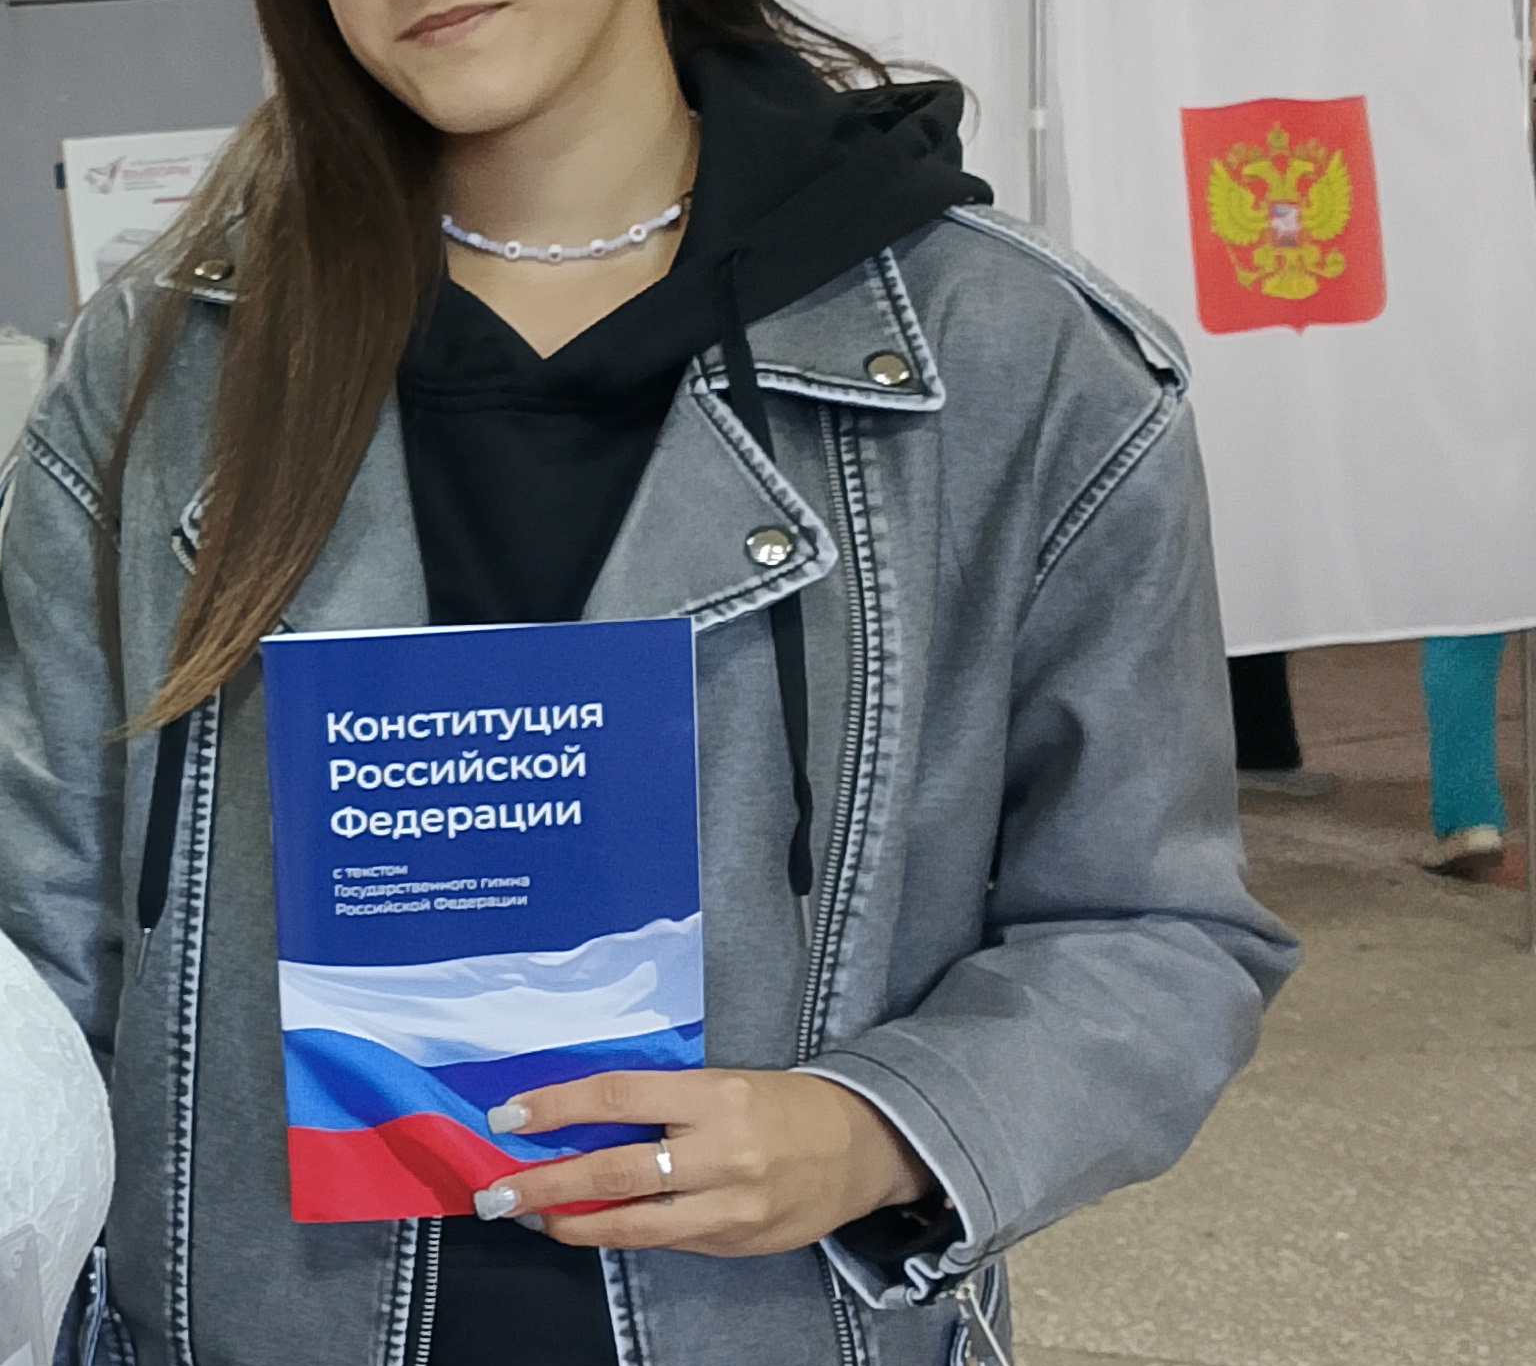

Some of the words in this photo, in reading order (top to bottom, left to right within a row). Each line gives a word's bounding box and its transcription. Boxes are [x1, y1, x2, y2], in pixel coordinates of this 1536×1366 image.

[327, 702, 604, 743] Конституция
[329, 744, 587, 791] Российской
[330, 799, 582, 839] Федерации
[333, 868, 343, 880] с
[344, 865, 409, 879] текстом
[334, 878, 478, 900] Государственного
[480, 876, 531, 889] гимна
[335, 898, 431, 916] Российской
[433, 895, 528, 911] Федерации
